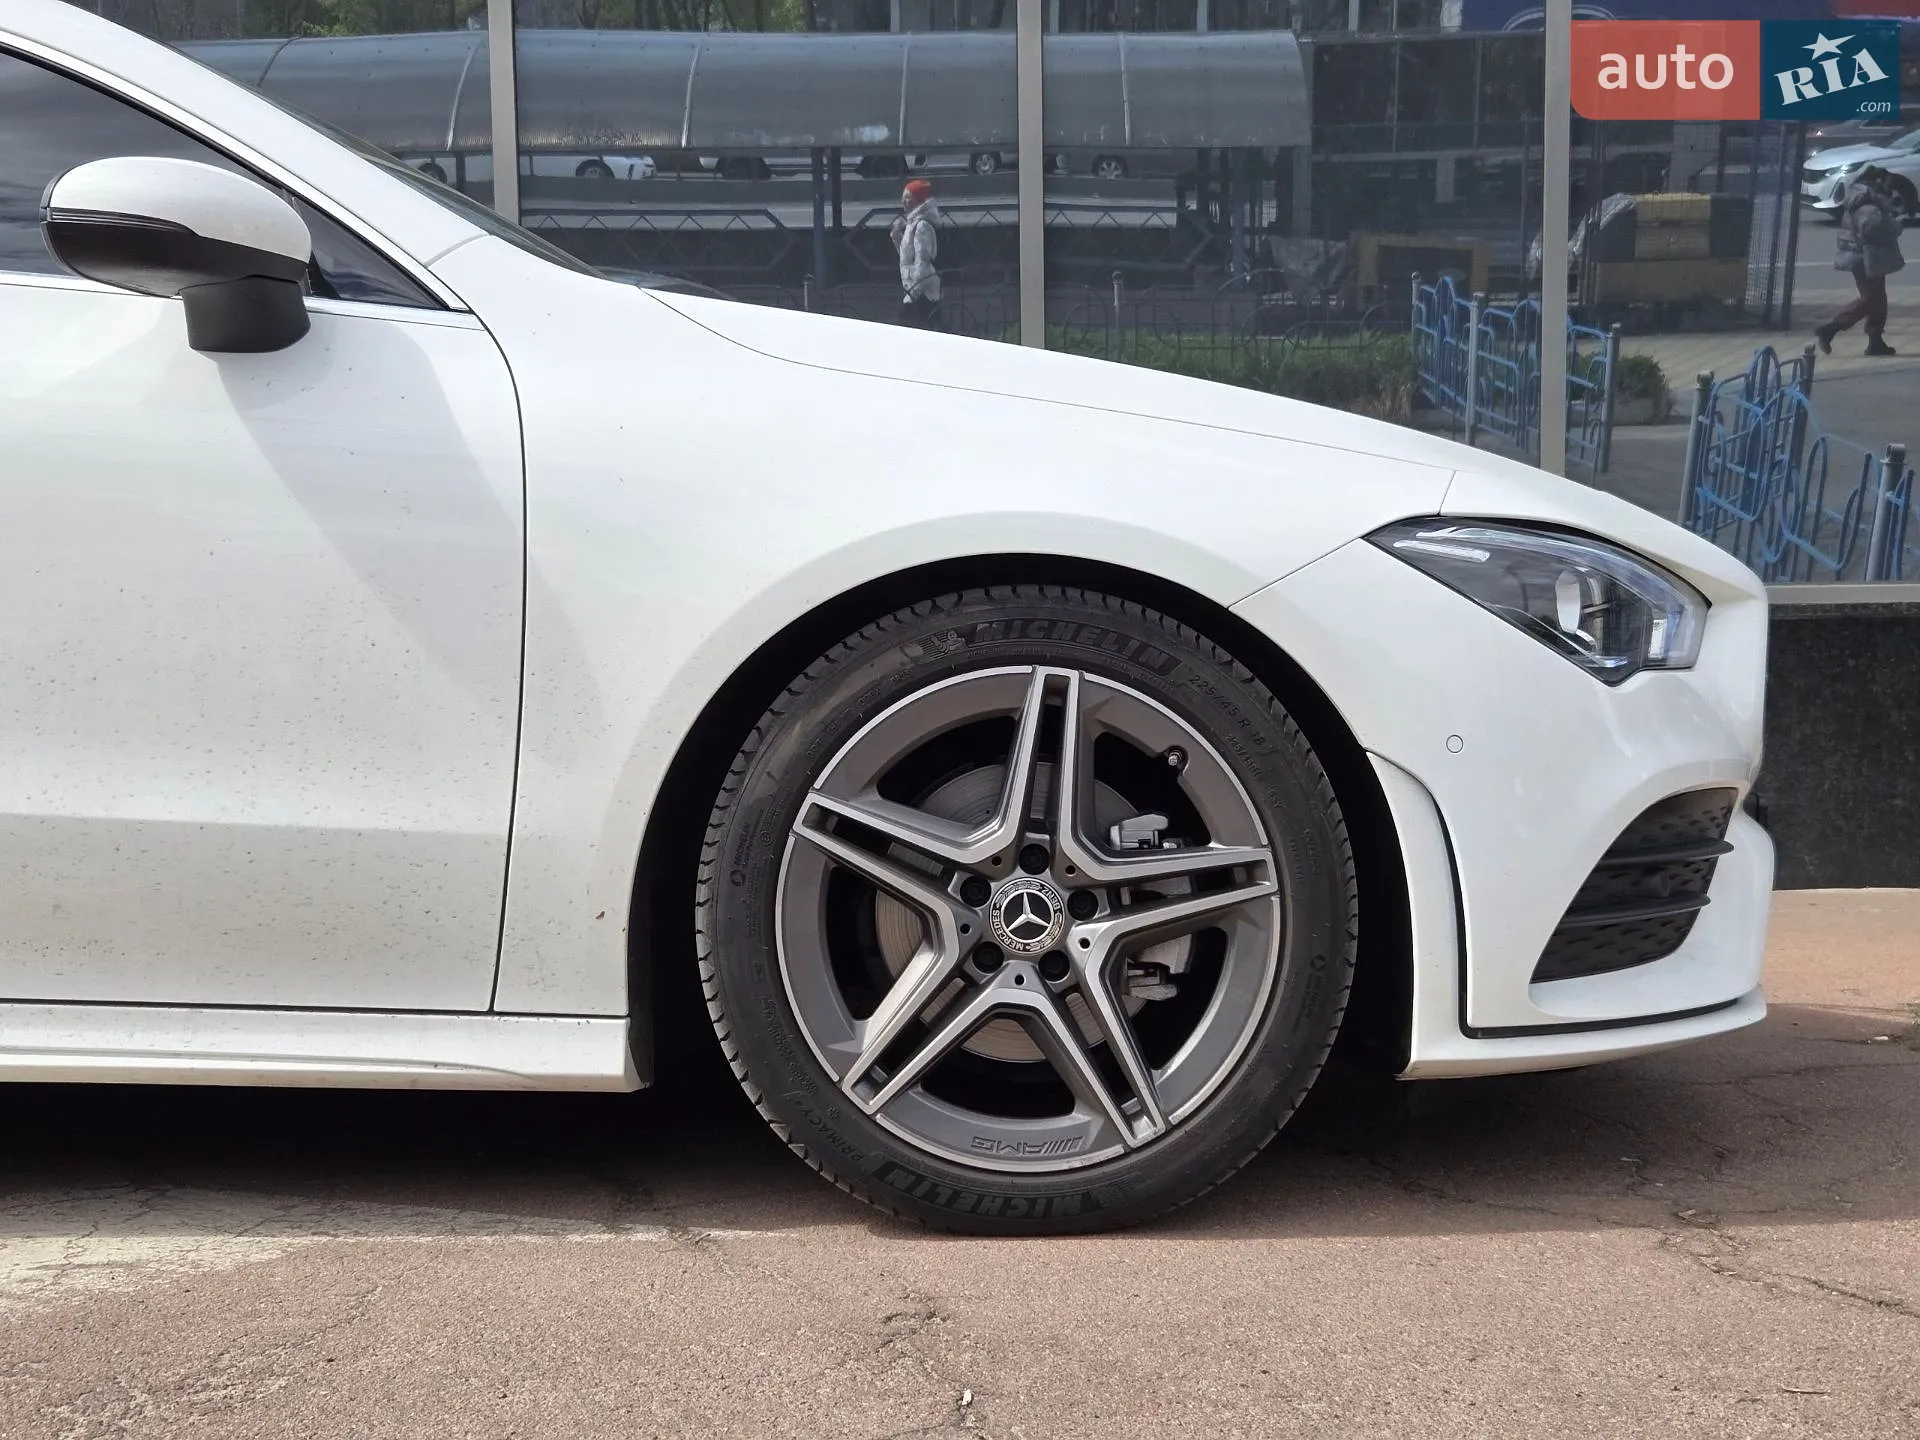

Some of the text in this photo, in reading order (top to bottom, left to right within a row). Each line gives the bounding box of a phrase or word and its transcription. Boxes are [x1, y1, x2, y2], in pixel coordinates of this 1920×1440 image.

[977, 620, 1167, 670] MICHELIN
[1189, 673, 1267, 748] 225/45 R 18
[1041, 886, 1061, 910] BENZ
[992, 909, 1024, 951] MERCEDES
[801, 1106, 864, 1163] PRIMACY
[971, 1135, 1050, 1156] AMG
[884, 1165, 1083, 1217] MICHELIN
